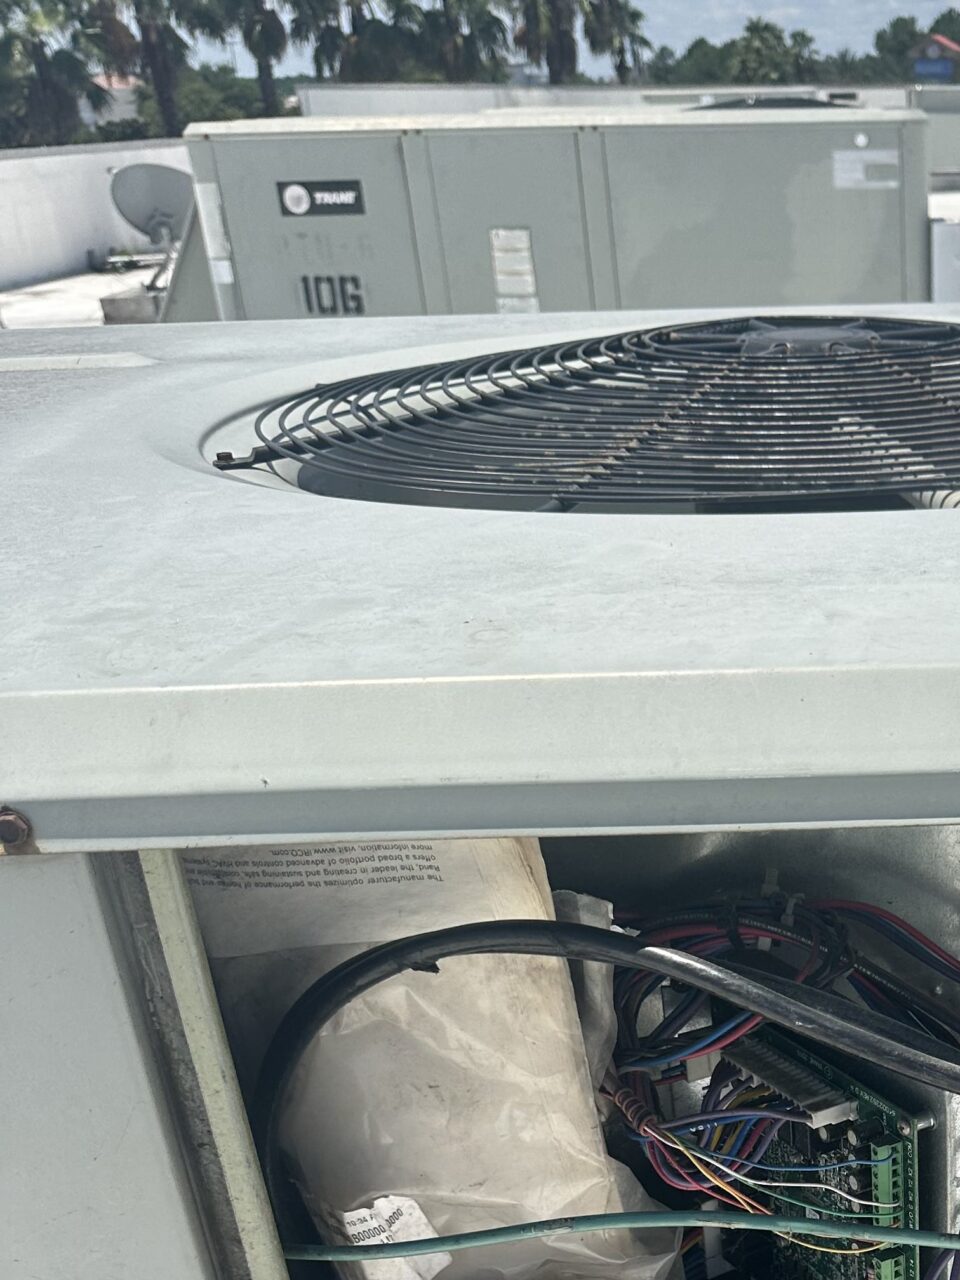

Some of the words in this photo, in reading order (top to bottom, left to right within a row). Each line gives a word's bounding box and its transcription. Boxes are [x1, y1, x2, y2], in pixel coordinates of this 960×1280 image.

[338, 846, 356, 855] visit
[411, 844, 432, 852] more
[338, 855, 375, 866] portfolio
[377, 855, 403, 864] broad
[412, 854, 436, 863] offers
[251, 860, 284, 868] controls
[286, 859, 325, 868] advanced
[306, 869, 320, 877] and
[323, 866, 357, 877] creating
[371, 866, 398, 875] leader
[400, 865, 414, 873] the
[262, 869, 303, 879] sustaining
[427, 874, 443, 882] The
[254, 880, 305, 889] performance
[308, 880, 321, 888] the
[324, 878, 364, 888] optimizes
[368, 875, 425, 885] manufacturer
